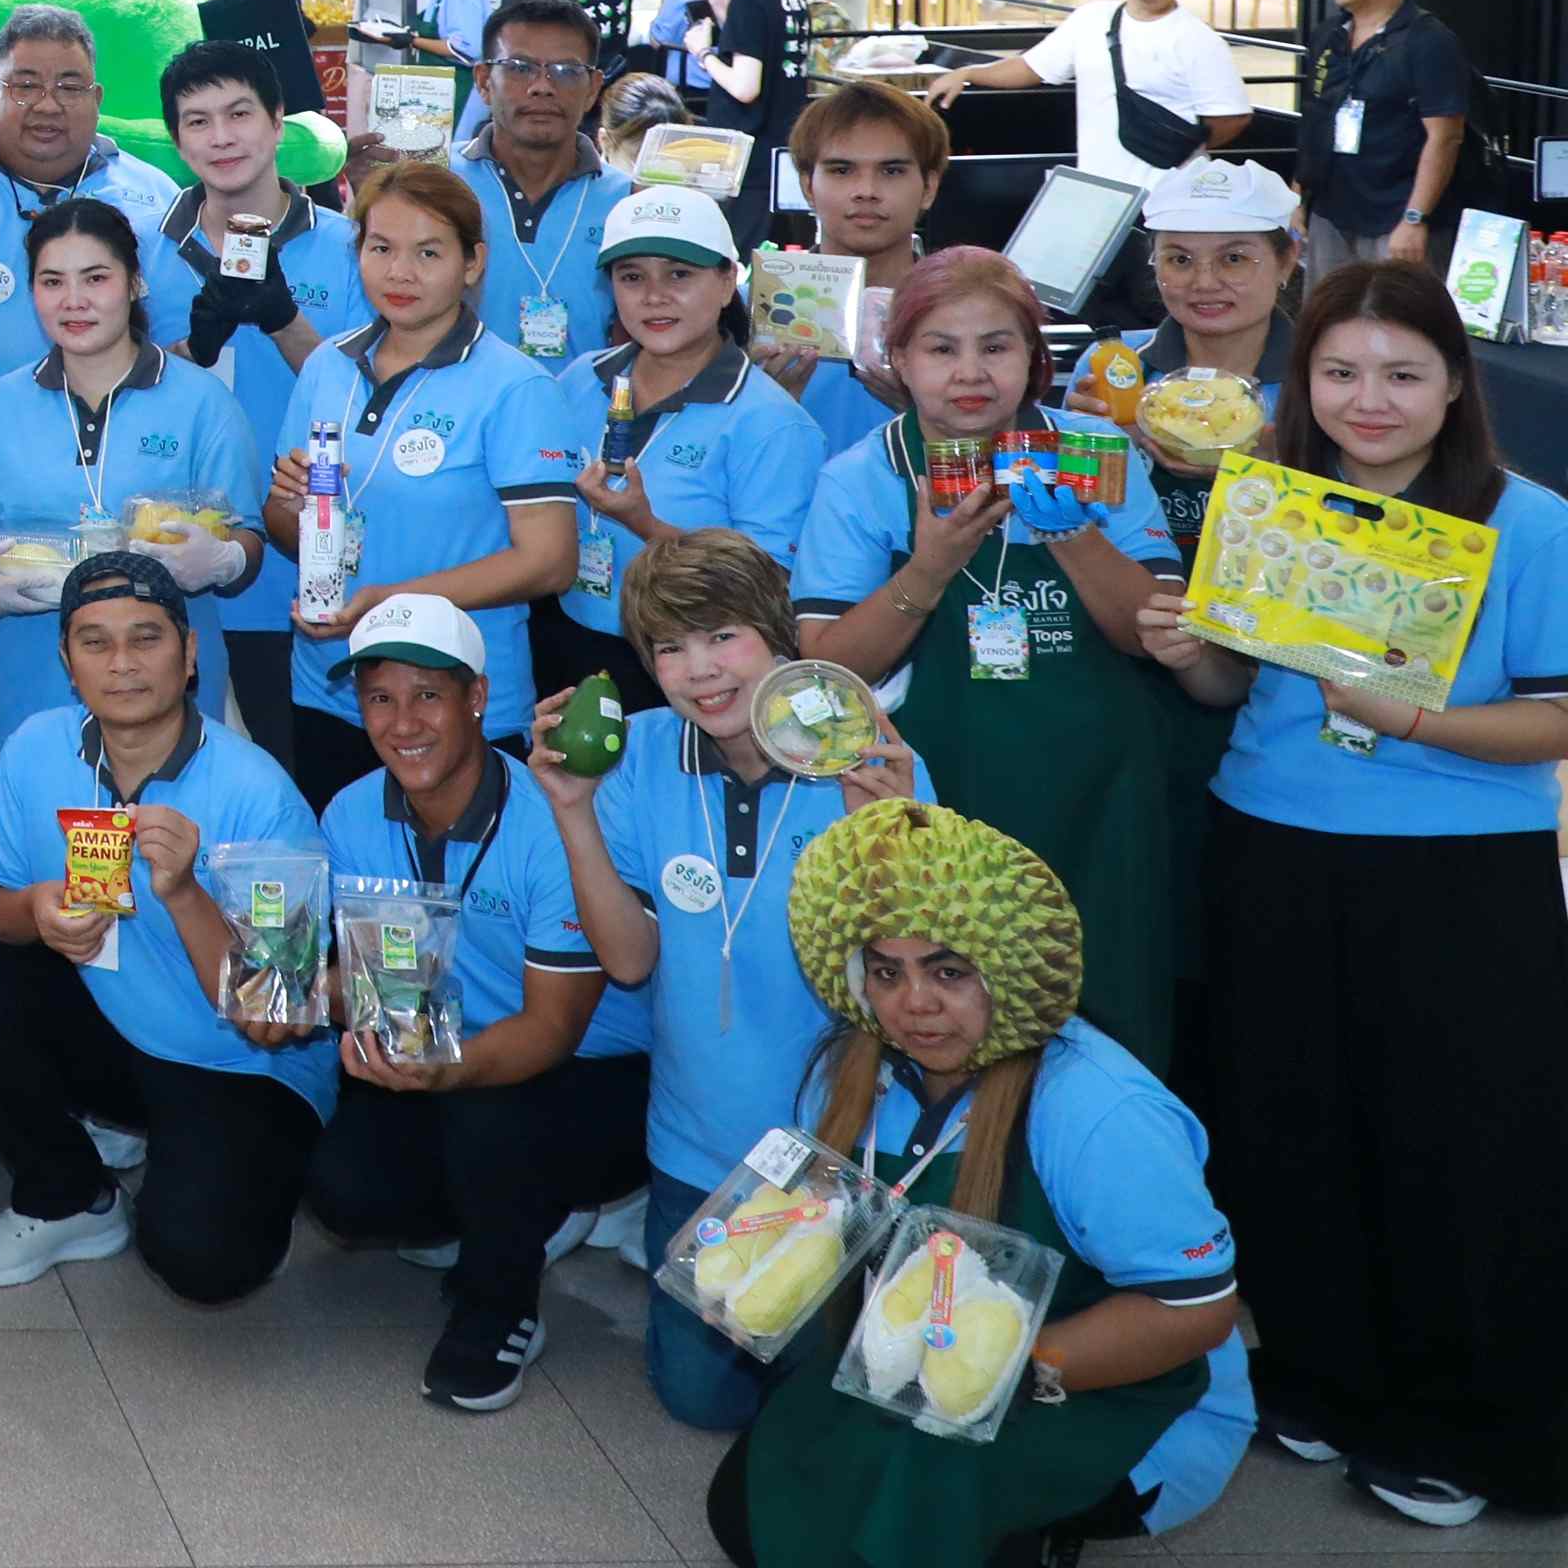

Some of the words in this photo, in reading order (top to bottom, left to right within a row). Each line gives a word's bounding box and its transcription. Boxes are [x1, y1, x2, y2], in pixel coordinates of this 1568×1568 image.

[1029, 629, 1073, 644] Tops
[978, 646, 1020, 658] VENDOR
[72, 831, 130, 847] AMATA
[71, 846, 131, 862] PEANUT
[561, 920, 583, 933] Top
[1182, 1240, 1214, 1261] Tops
